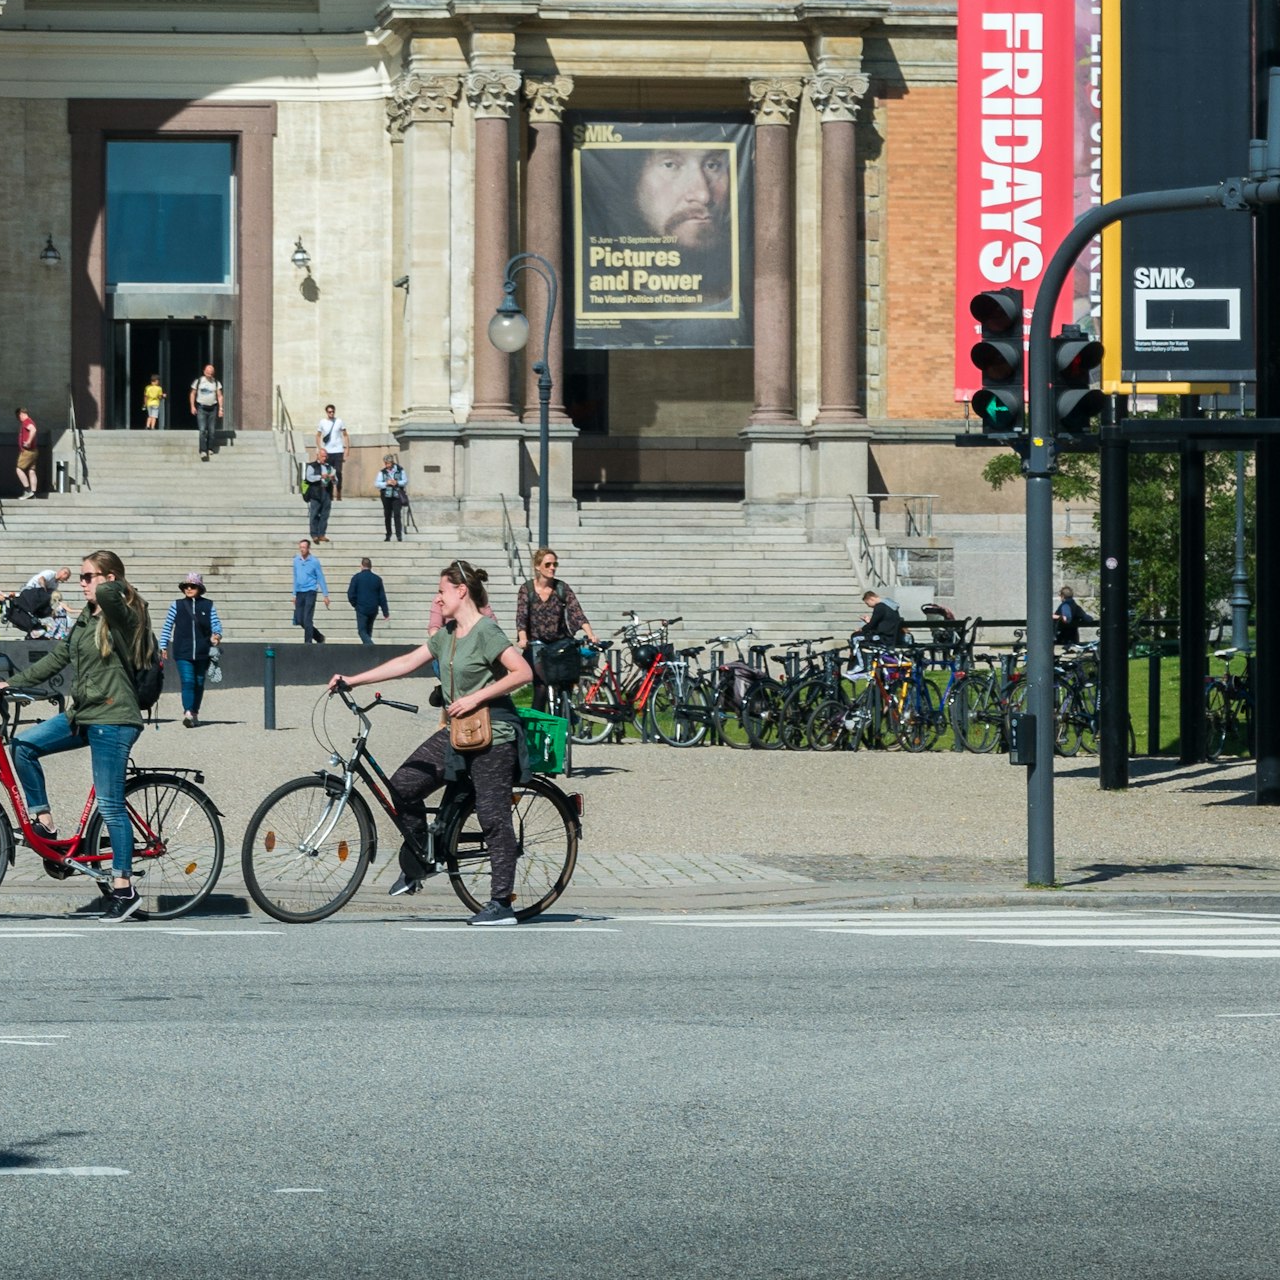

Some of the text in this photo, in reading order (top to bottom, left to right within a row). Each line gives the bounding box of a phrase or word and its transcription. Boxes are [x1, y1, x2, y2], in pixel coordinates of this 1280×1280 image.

[573, 124, 615, 142] SMK
[978, 12, 1044, 284] FRIDAYS
[589, 246, 681, 268] Pictures
[589, 269, 703, 291] and Power
[1134, 267, 1186, 289] SMK
[590, 295, 603, 304] The
